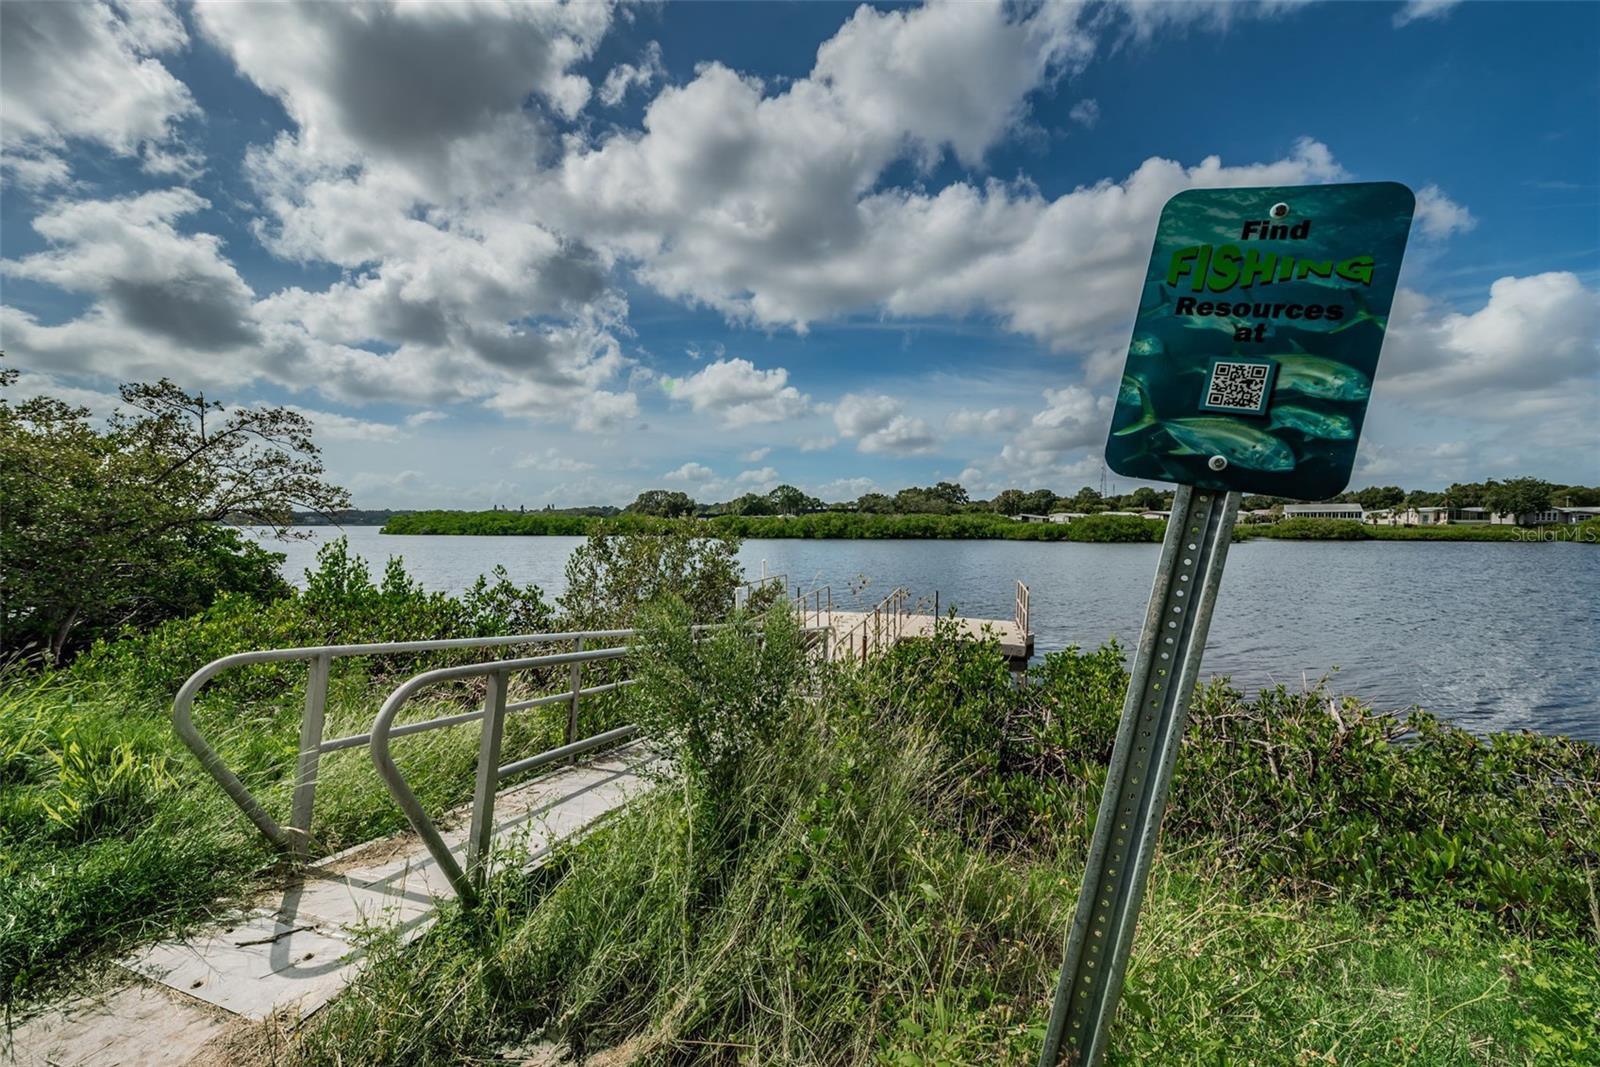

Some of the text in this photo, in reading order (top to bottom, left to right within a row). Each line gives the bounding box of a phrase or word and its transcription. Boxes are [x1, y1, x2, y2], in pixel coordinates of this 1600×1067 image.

[1241, 219, 1311, 241] Find
[1166, 244, 1375, 293] FISHING
[1175, 296, 1345, 321] Resources
[1233, 323, 1267, 343] at
